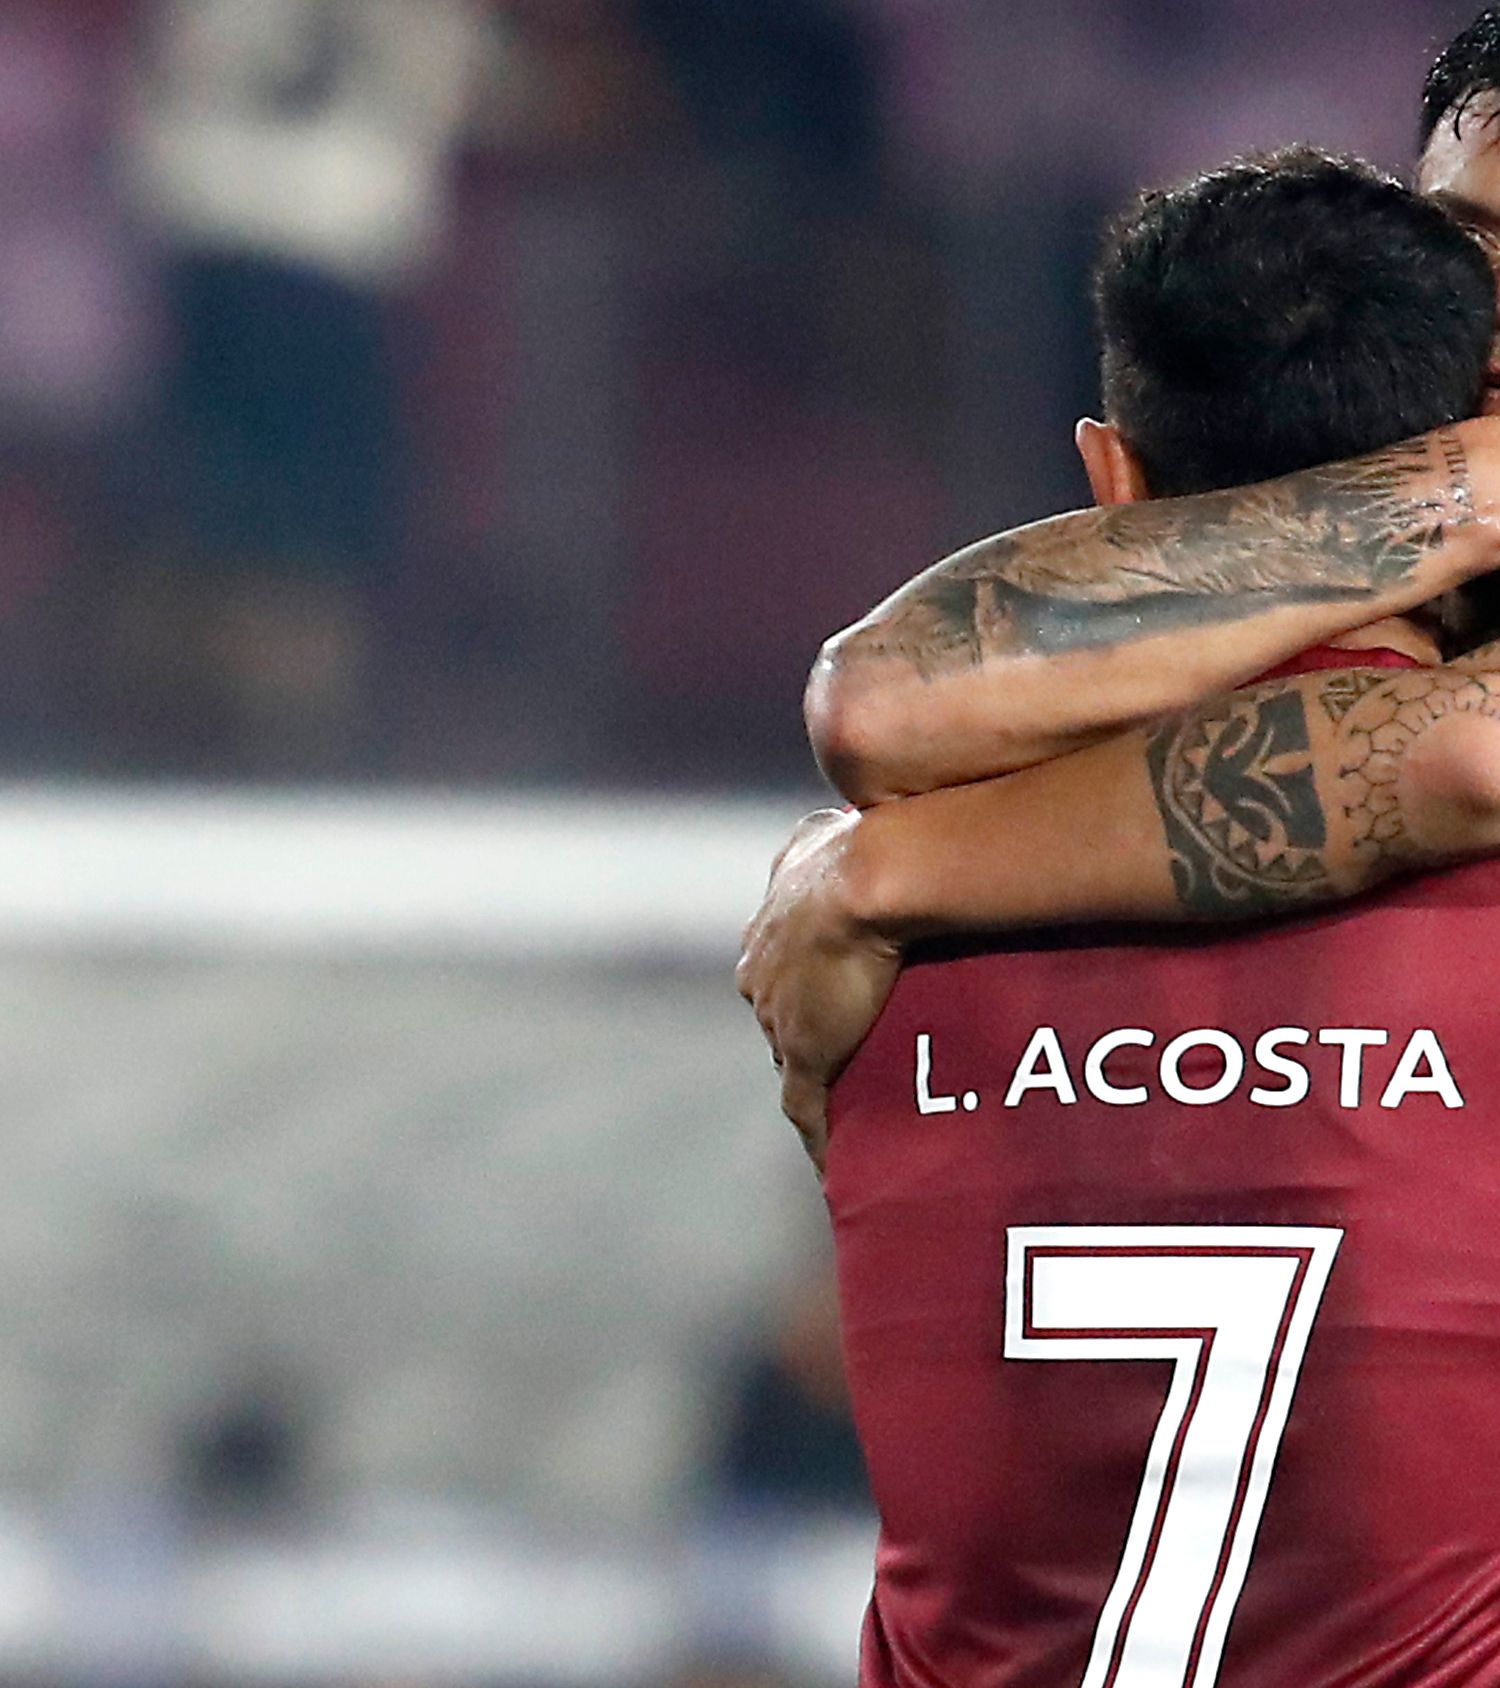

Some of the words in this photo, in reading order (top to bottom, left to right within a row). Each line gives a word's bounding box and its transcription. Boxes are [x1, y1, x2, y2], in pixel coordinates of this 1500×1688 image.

[915, 1033, 979, 1115] L.
[1003, 1026, 1465, 1108] ACOSTA
[1003, 1224, 1345, 1688] 7
